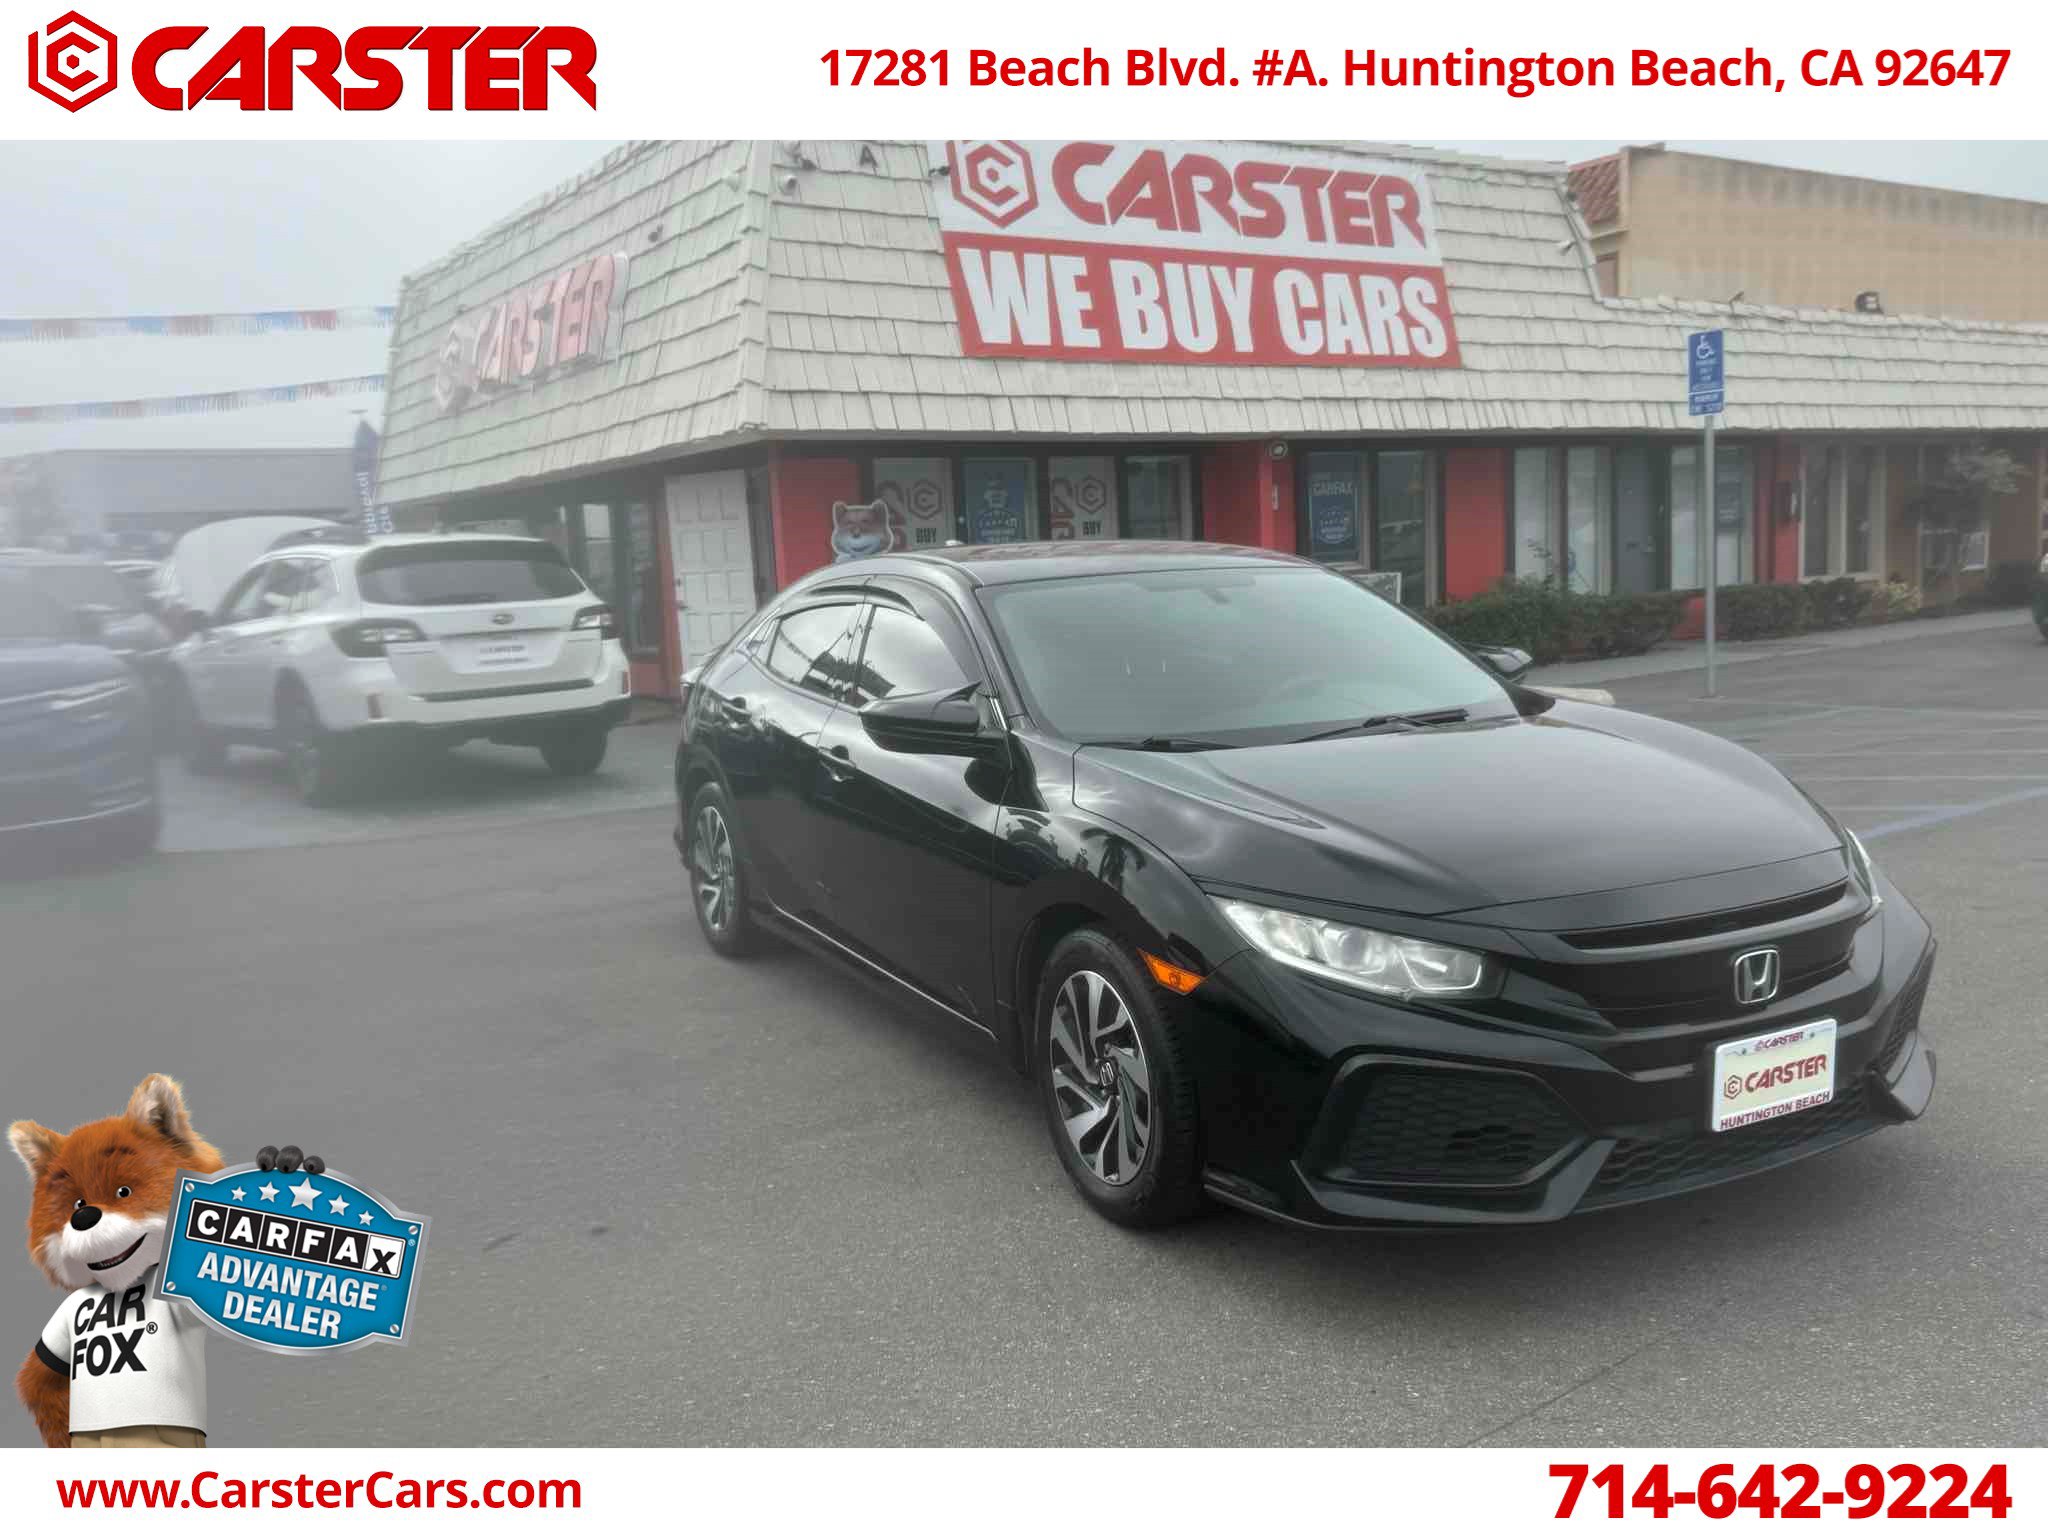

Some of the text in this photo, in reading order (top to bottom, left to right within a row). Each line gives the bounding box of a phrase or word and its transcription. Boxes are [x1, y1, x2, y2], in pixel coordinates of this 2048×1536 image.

[1051, 141, 1427, 249] CARSTER
[472, 255, 616, 392] CARSTER
[957, 247, 1449, 358] WE BUY CARS
[1719, 1090, 1831, 1130] HUNTINGTON BEACH
[1744, 1054, 1828, 1094] CARSTER
